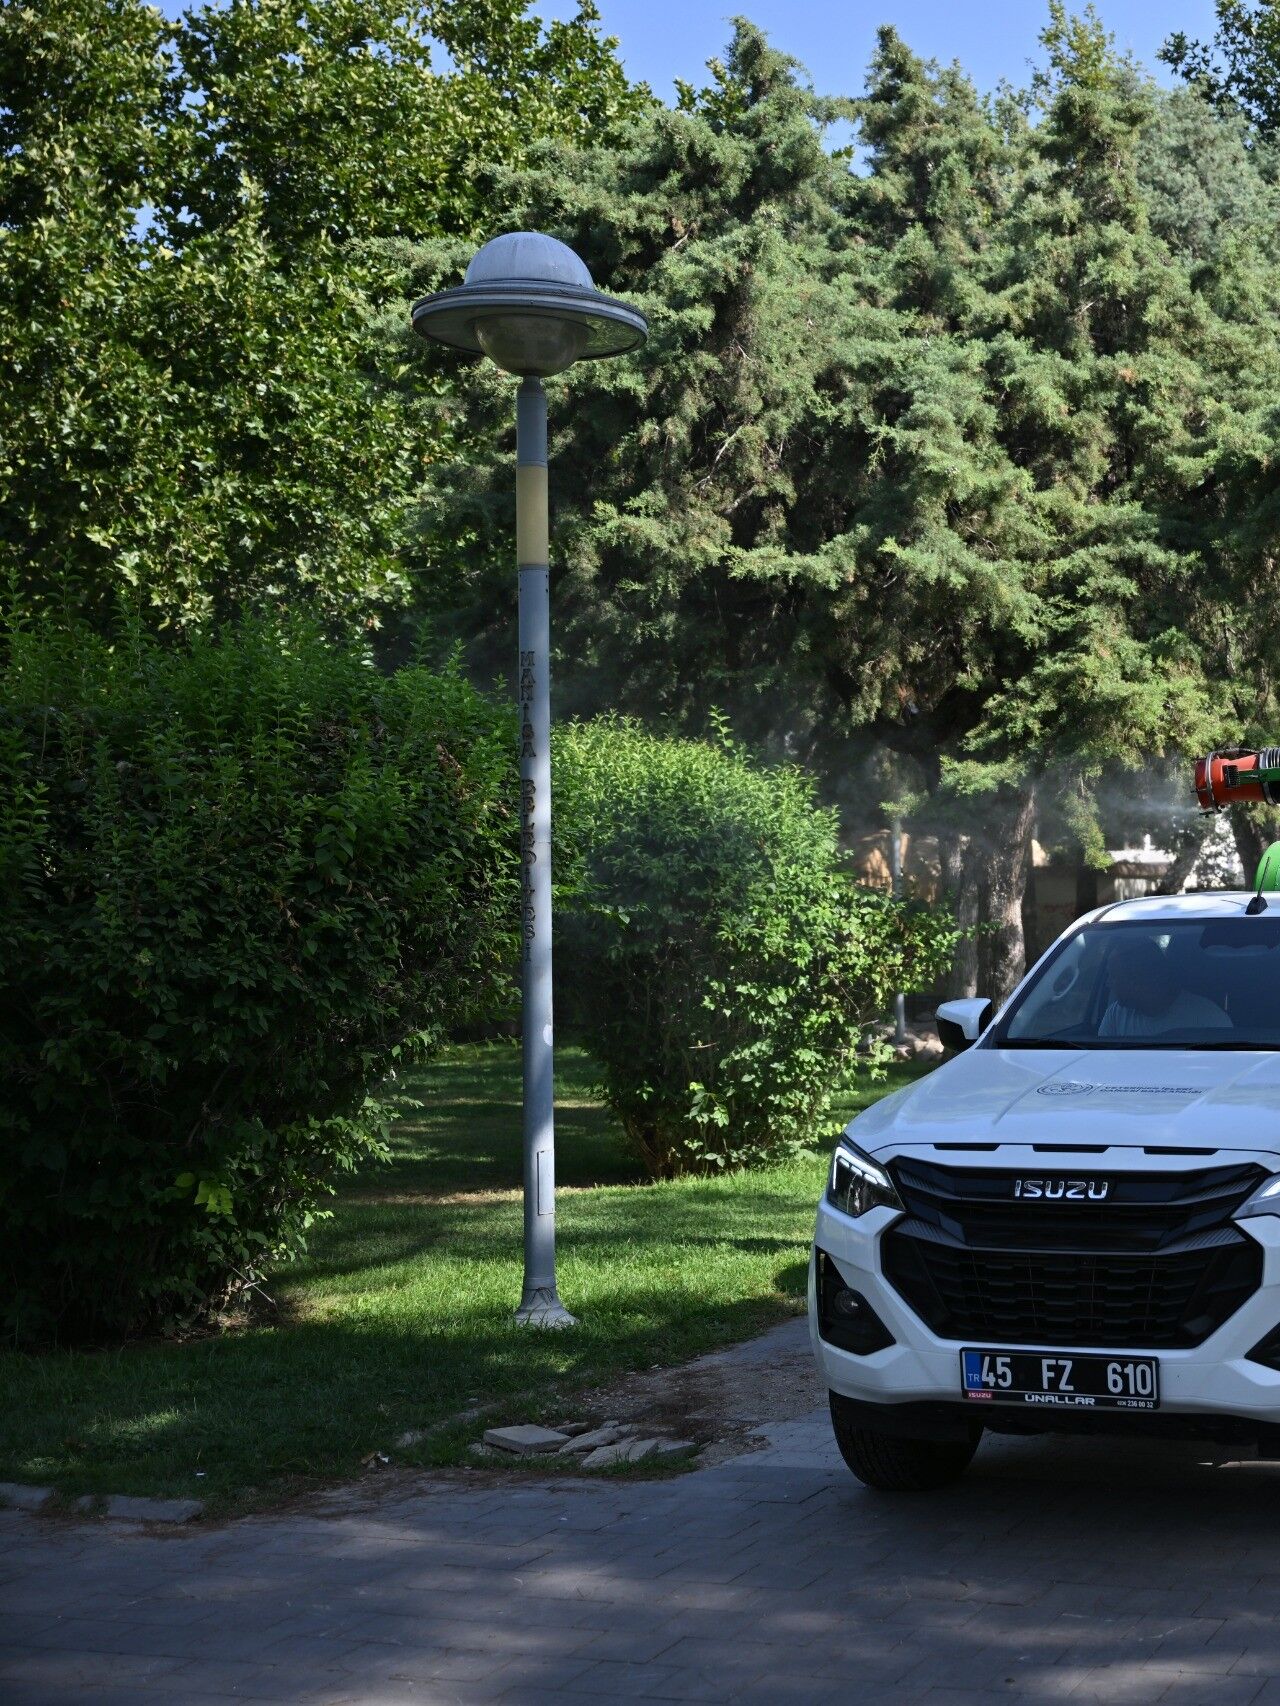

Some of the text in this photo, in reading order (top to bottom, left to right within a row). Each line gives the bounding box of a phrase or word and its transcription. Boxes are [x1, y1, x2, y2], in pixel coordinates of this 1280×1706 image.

[1014, 1180, 1109, 1199] ISUZU
[967, 1355, 1152, 1395] TR 45 FZ 610
[968, 1391, 992, 1399] ISUZU
